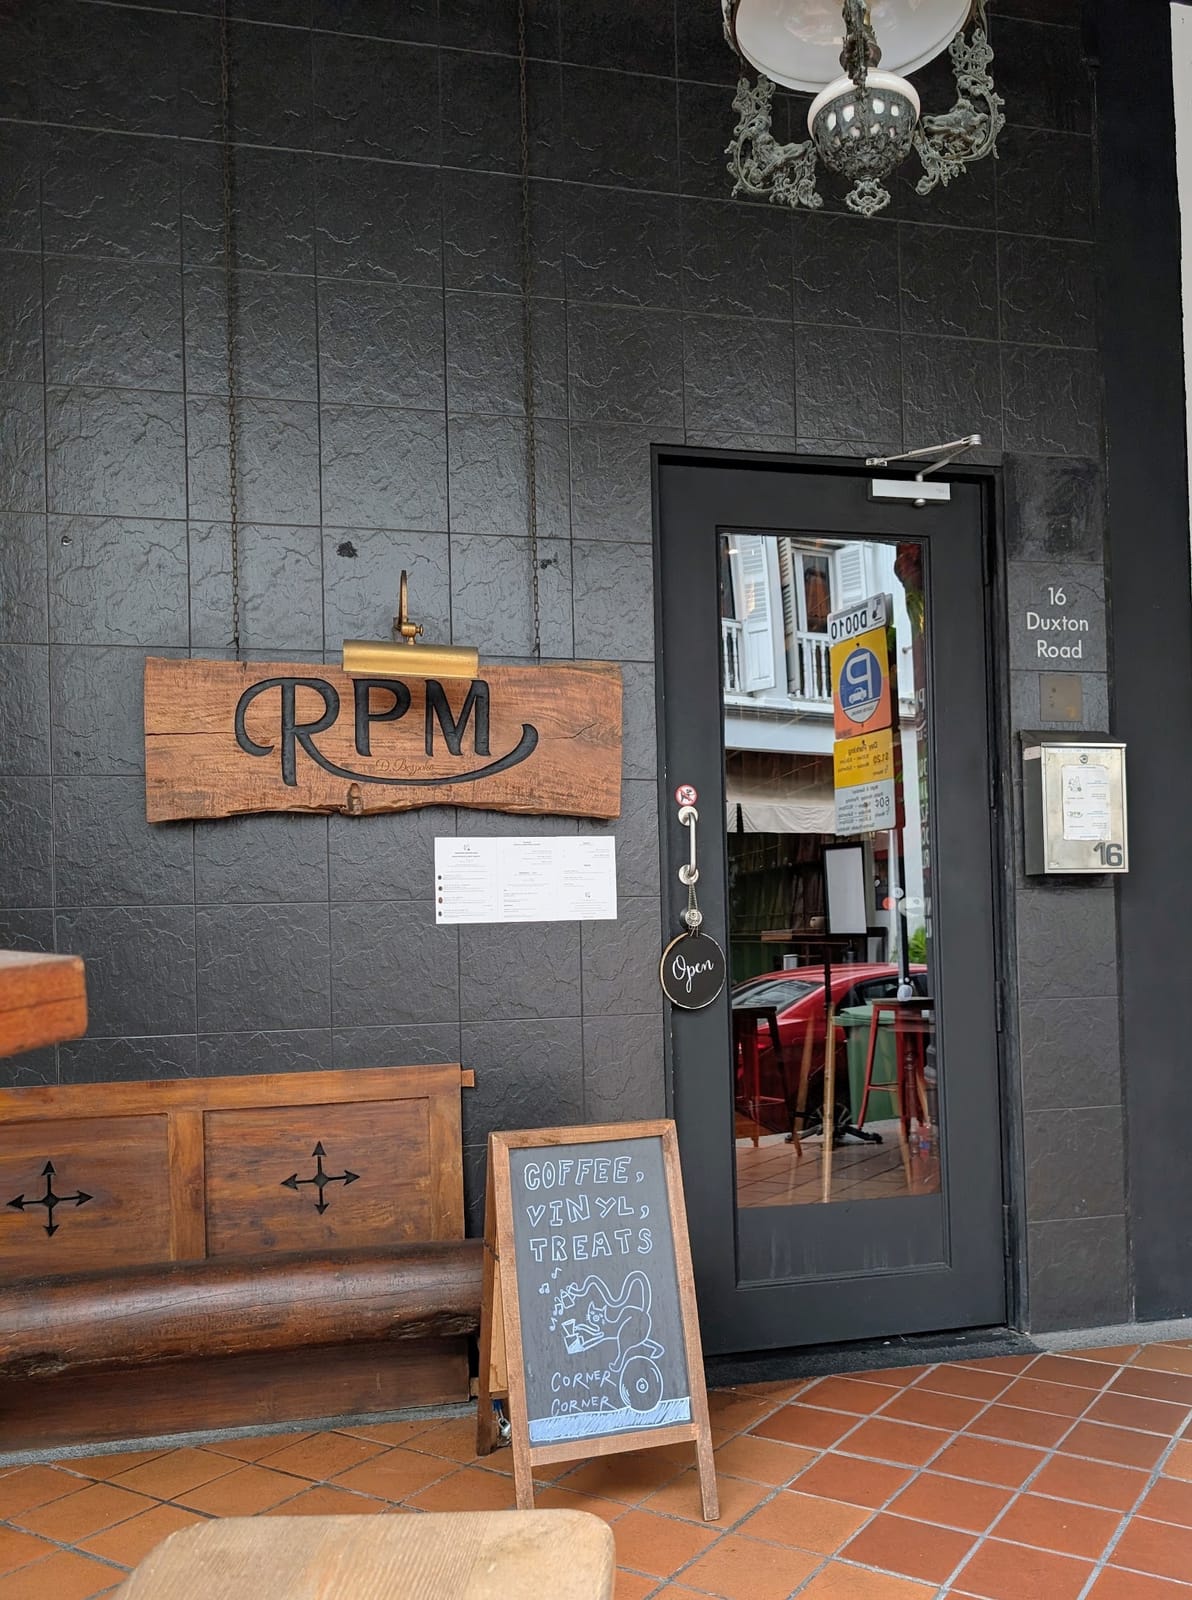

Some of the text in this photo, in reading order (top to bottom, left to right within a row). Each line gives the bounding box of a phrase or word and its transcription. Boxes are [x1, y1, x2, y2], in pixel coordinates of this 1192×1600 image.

[1048, 587, 1067, 606] 16
[1026, 611, 1089, 632] Duxton
[1037, 639, 1082, 659] Road
[234, 676, 539, 787] RPM
[1093, 842, 1123, 867] 16
[672, 954, 714, 993] Open
[524, 1156, 645, 1190] COFFEE,
[526, 1194, 650, 1228] VINYL,
[529, 1228, 653, 1262] TREATS
[551, 1370, 617, 1392] CORNER
[551, 1396, 618, 1417] CORNER
